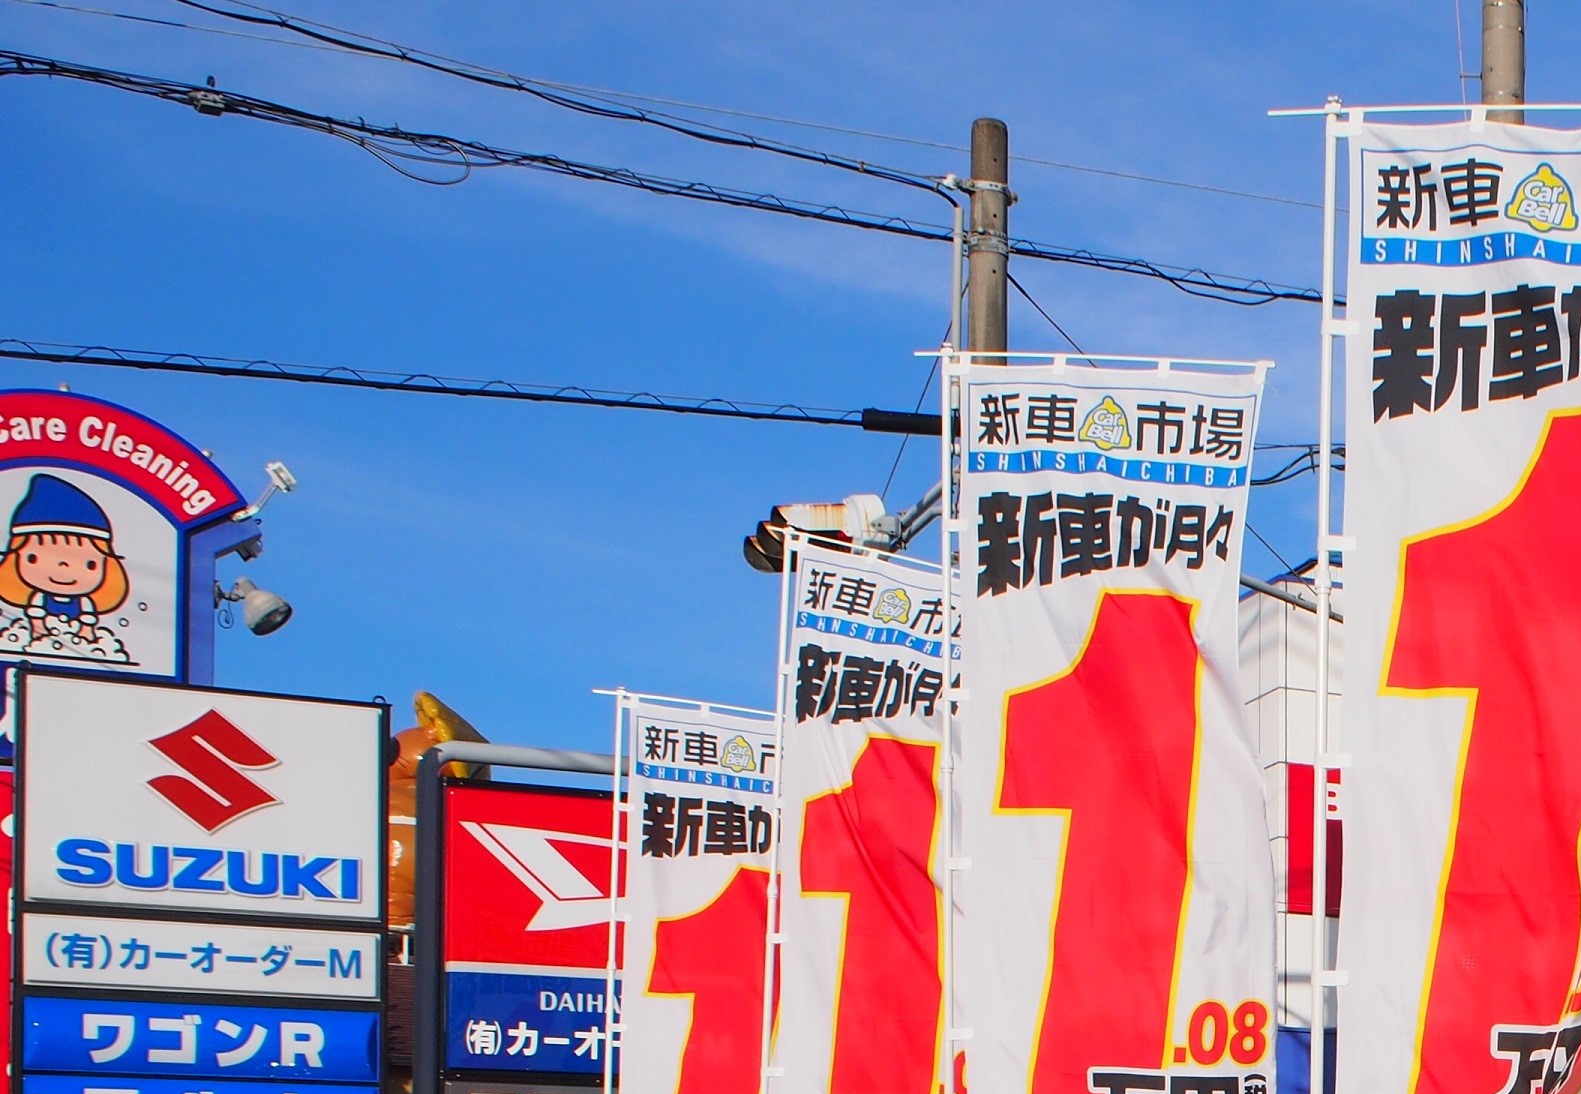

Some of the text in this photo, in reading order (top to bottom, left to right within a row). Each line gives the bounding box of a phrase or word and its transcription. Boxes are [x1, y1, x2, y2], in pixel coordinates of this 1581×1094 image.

[1376, 157, 1503, 232] 新車
[1517, 199, 1567, 227] Bell
[1522, 180, 1563, 204] Car
[977, 392, 1245, 461] 新車 市場
[1085, 424, 1124, 445] Bell
[1091, 407, 1122, 426] Car
[79, 416, 216, 515] Cleaning
[976, 451, 1238, 488] SHINSHAICHIBA
[977, 491, 1235, 599] 新車が月々
[804, 568, 877, 615] 新車
[644, 725, 719, 766] 新車
[56, 838, 362, 903] SUZUKI
[46, 932, 362, 979] (有)カーオーダーM
[82, 1013, 326, 1068] ワゴンR
[1172, 1000, 1270, 1067] .08
